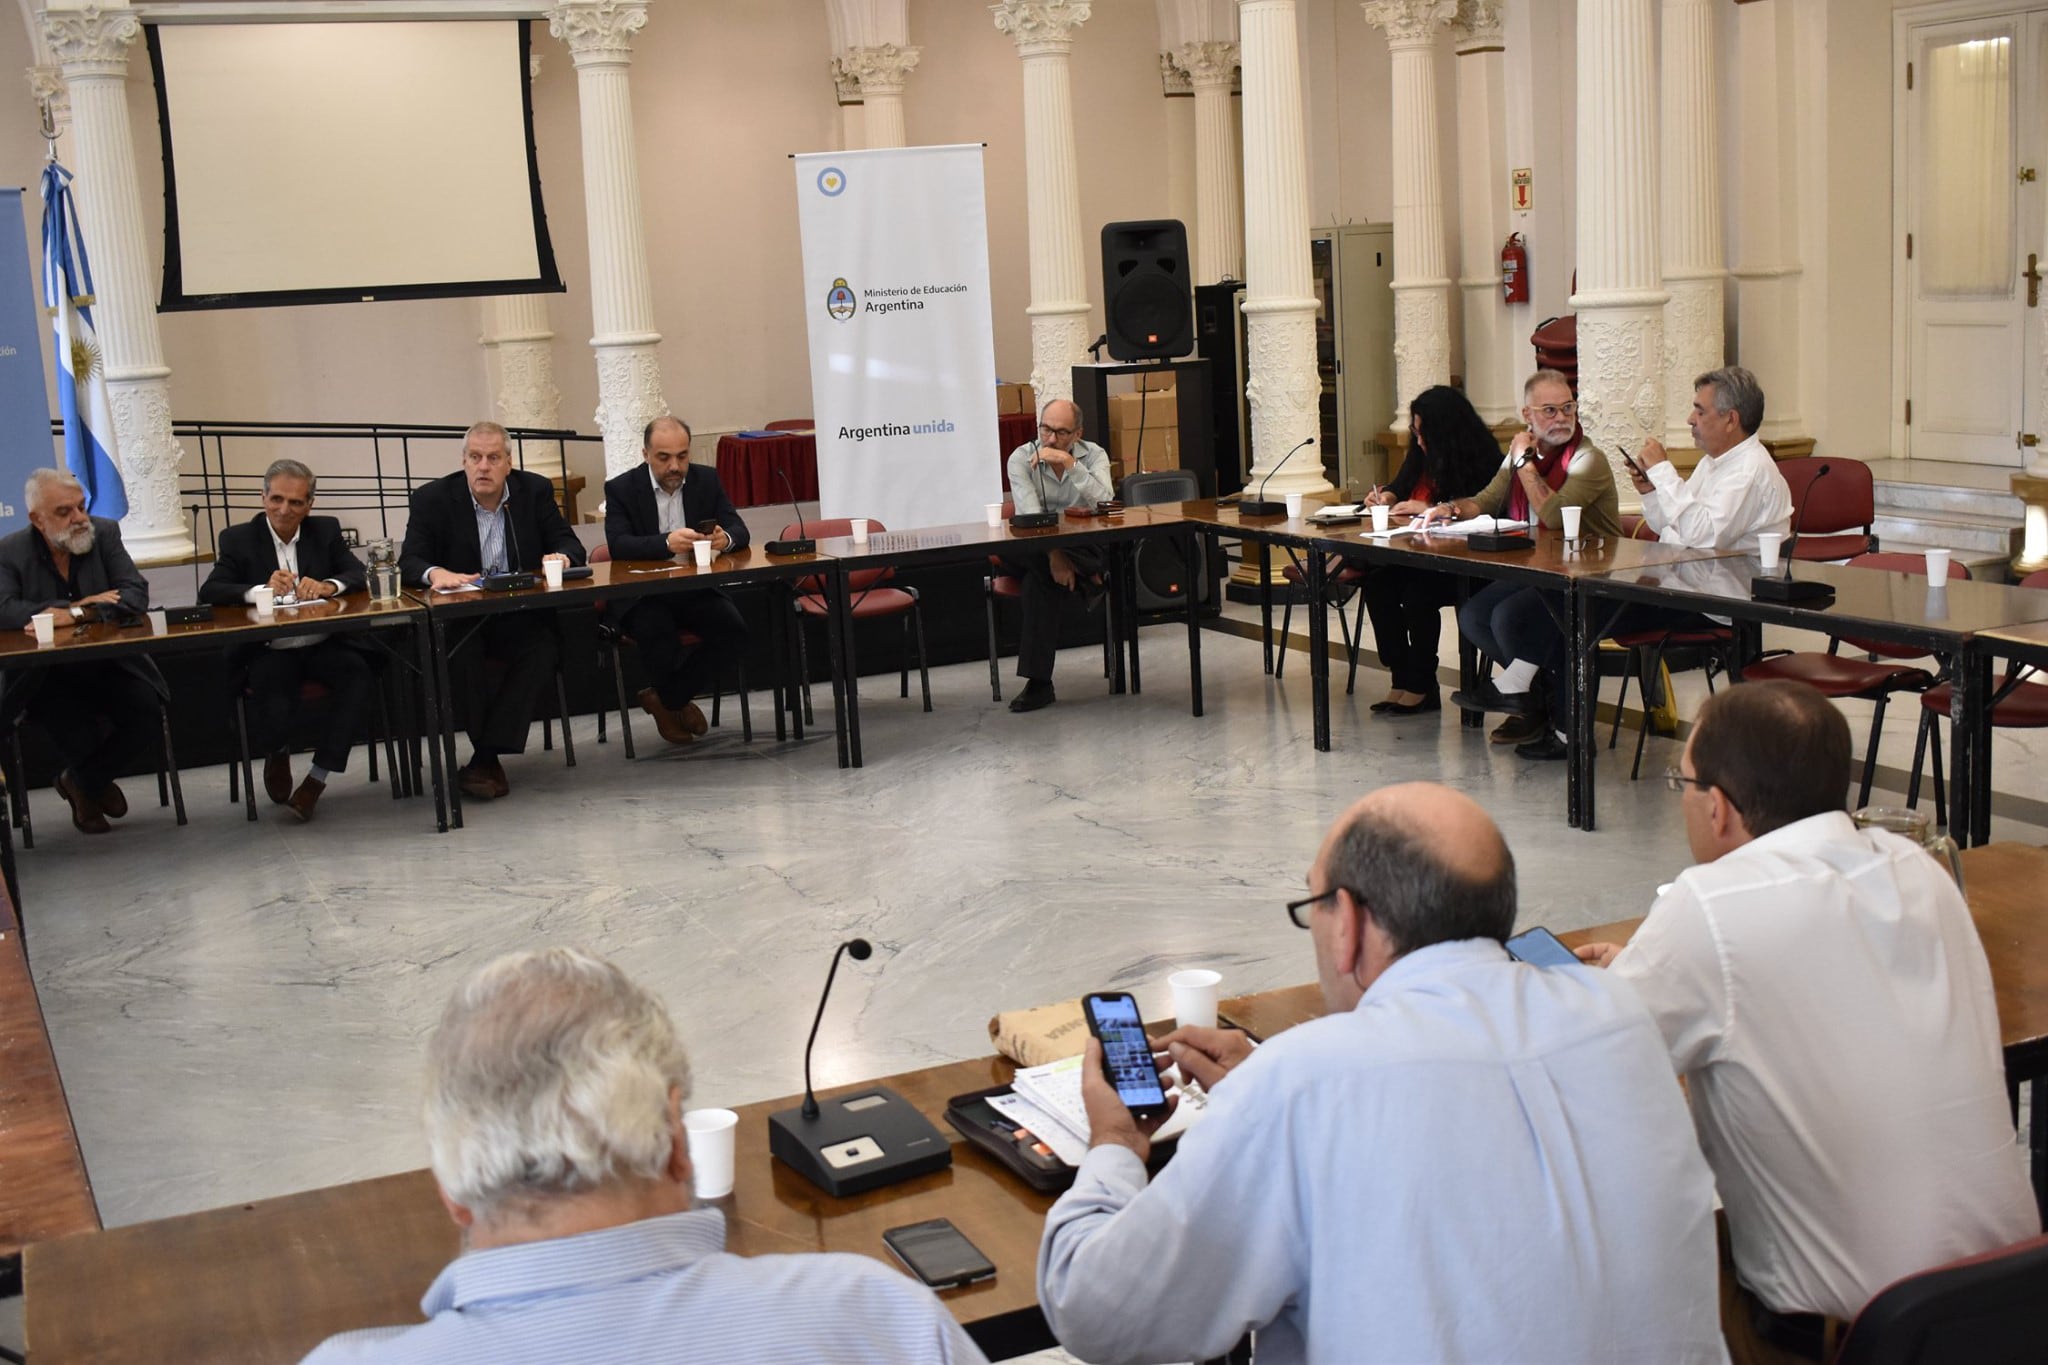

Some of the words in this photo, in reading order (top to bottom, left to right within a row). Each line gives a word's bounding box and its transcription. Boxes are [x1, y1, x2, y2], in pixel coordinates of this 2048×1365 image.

[864, 287, 909, 298] Ministerio
[910, 286, 921, 295] de
[923, 283, 968, 294] Educación
[865, 299, 924, 315] Argentina
[838, 423, 911, 441] Argentina
[913, 419, 955, 434] unida
